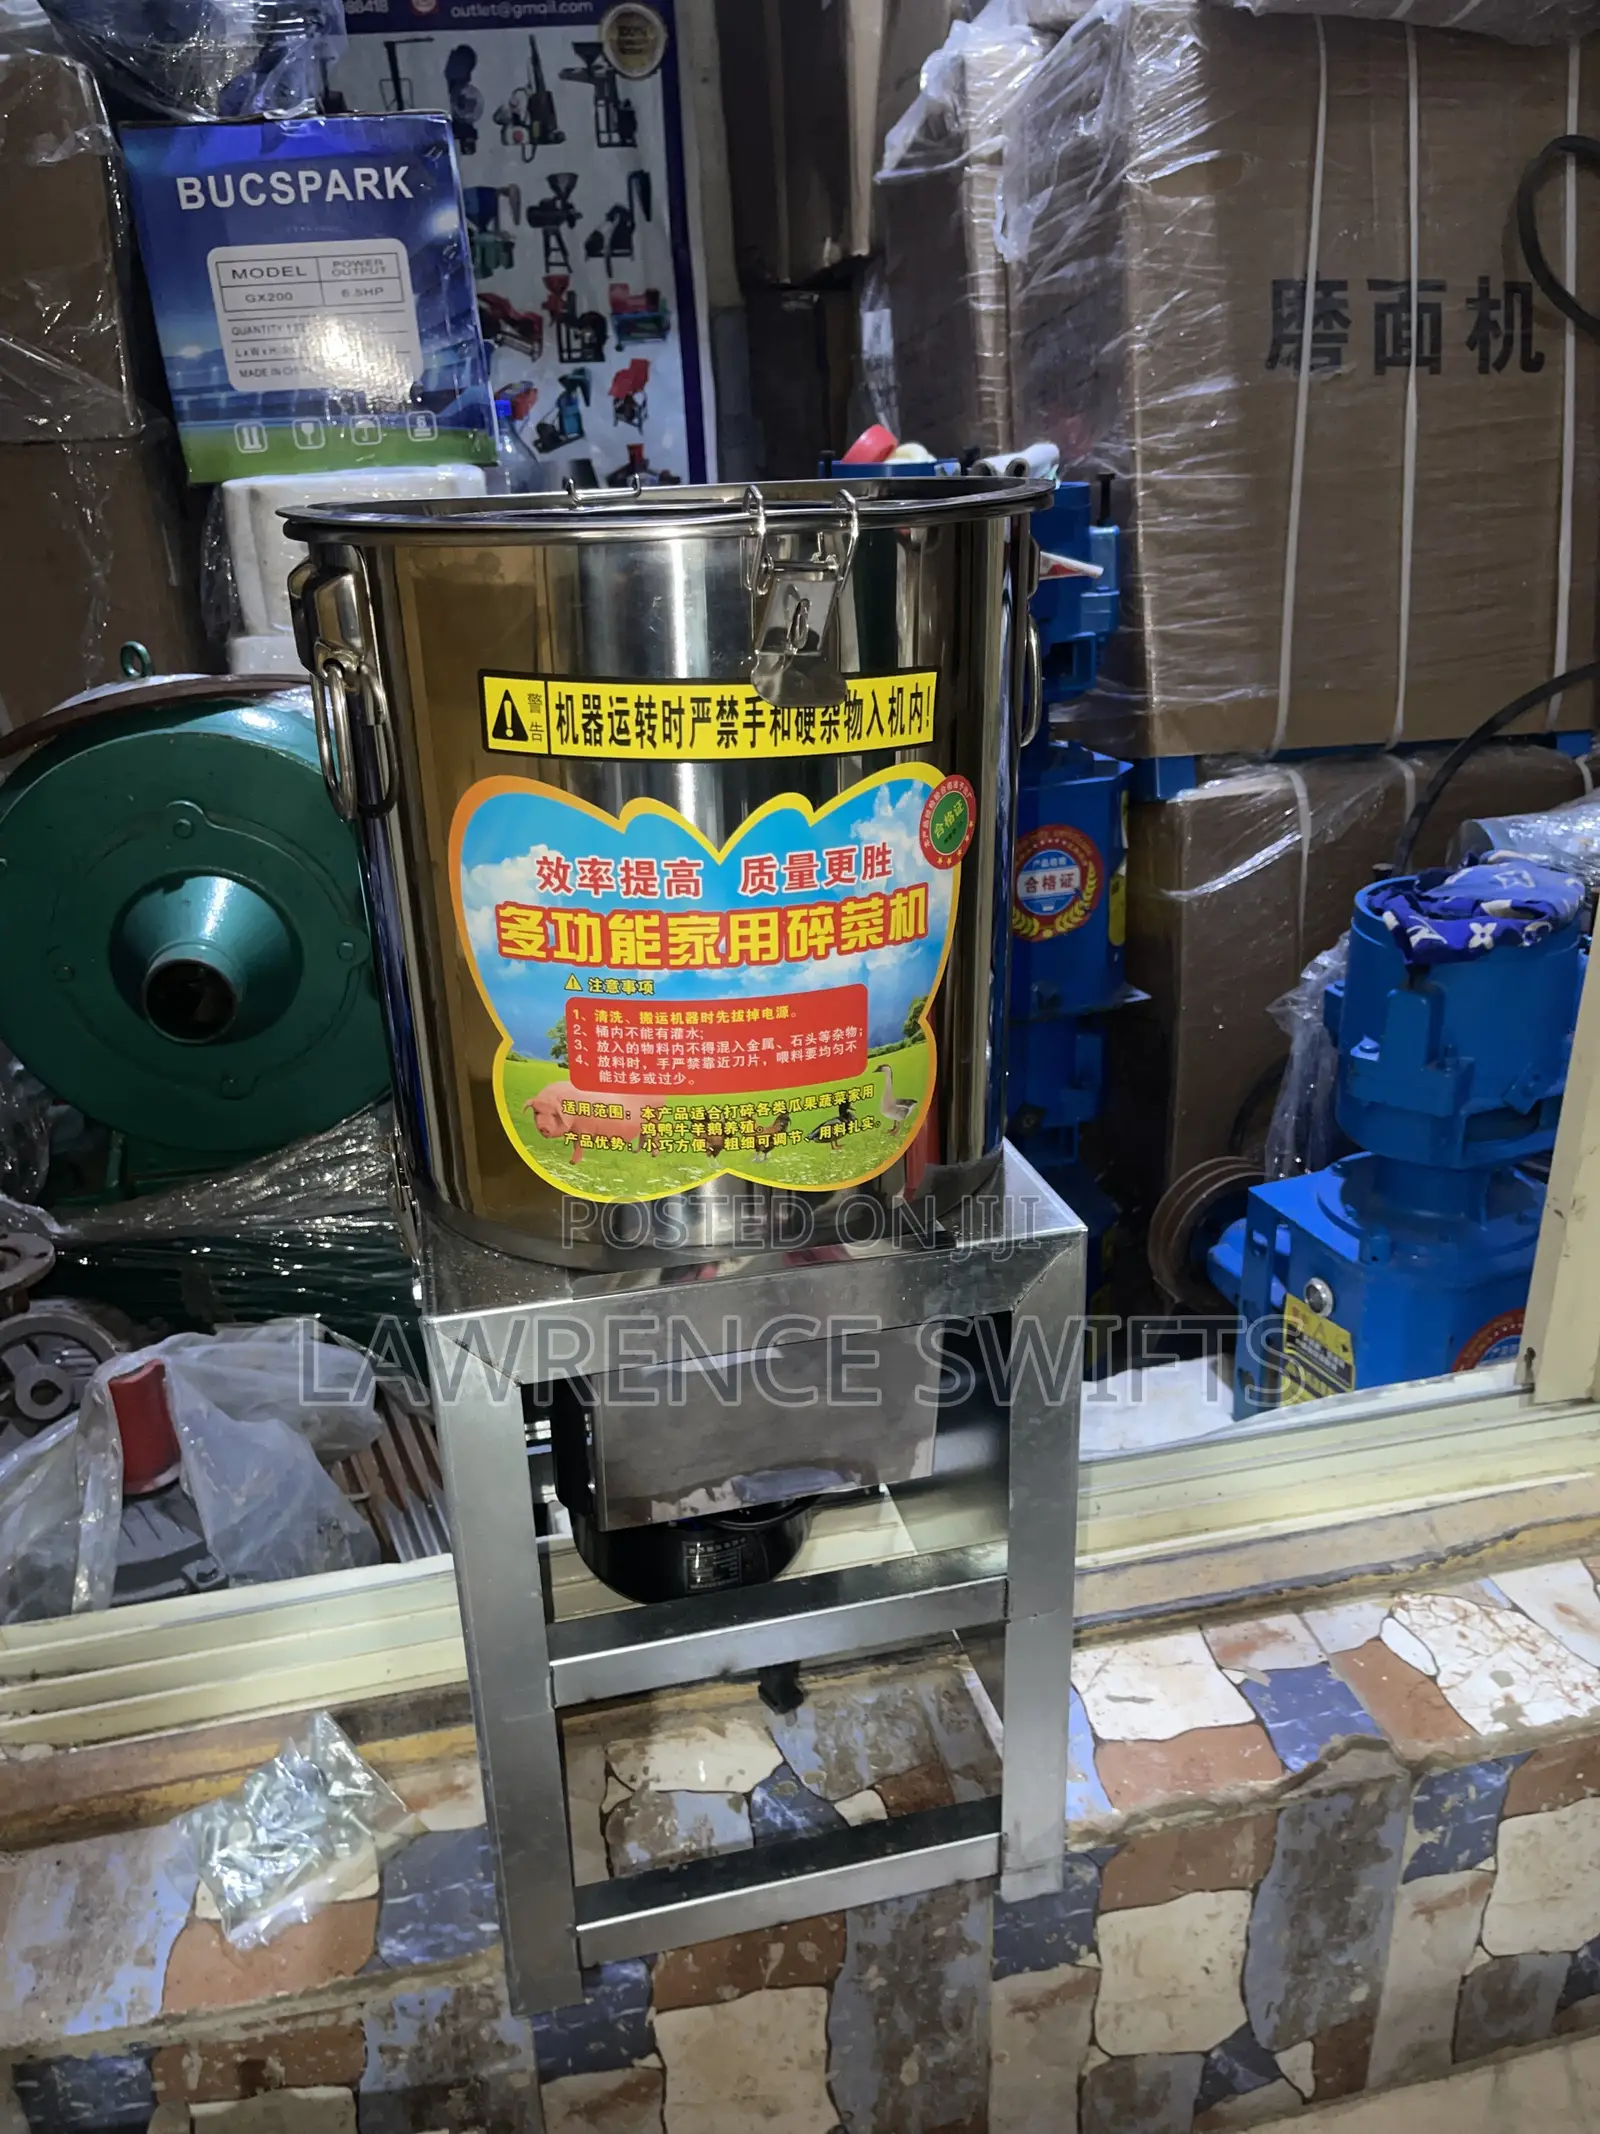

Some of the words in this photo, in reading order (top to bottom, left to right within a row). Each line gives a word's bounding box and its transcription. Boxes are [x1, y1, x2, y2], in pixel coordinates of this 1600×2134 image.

[176, 166, 414, 210] BUCSPARK
[231, 265, 308, 280] MODEL
[332, 266, 387, 277] OUTPUT
[333, 258, 384, 268] POWER
[244, 291, 294, 304] GX200
[1265, 275, 1545, 375] 磨面机
[238, 367, 269, 378] MADE
[527, 693, 544, 742] 警告
[536, 856, 704, 898] 效率提高
[740, 841, 894, 895] 质量更胜
[1024, 872, 1075, 893] 合格证
[498, 885, 928, 967] 多功能家用碎菜机
[588, 977, 655, 995] 注意事项
[599, 1068, 696, 1087] 能过多或过少。
